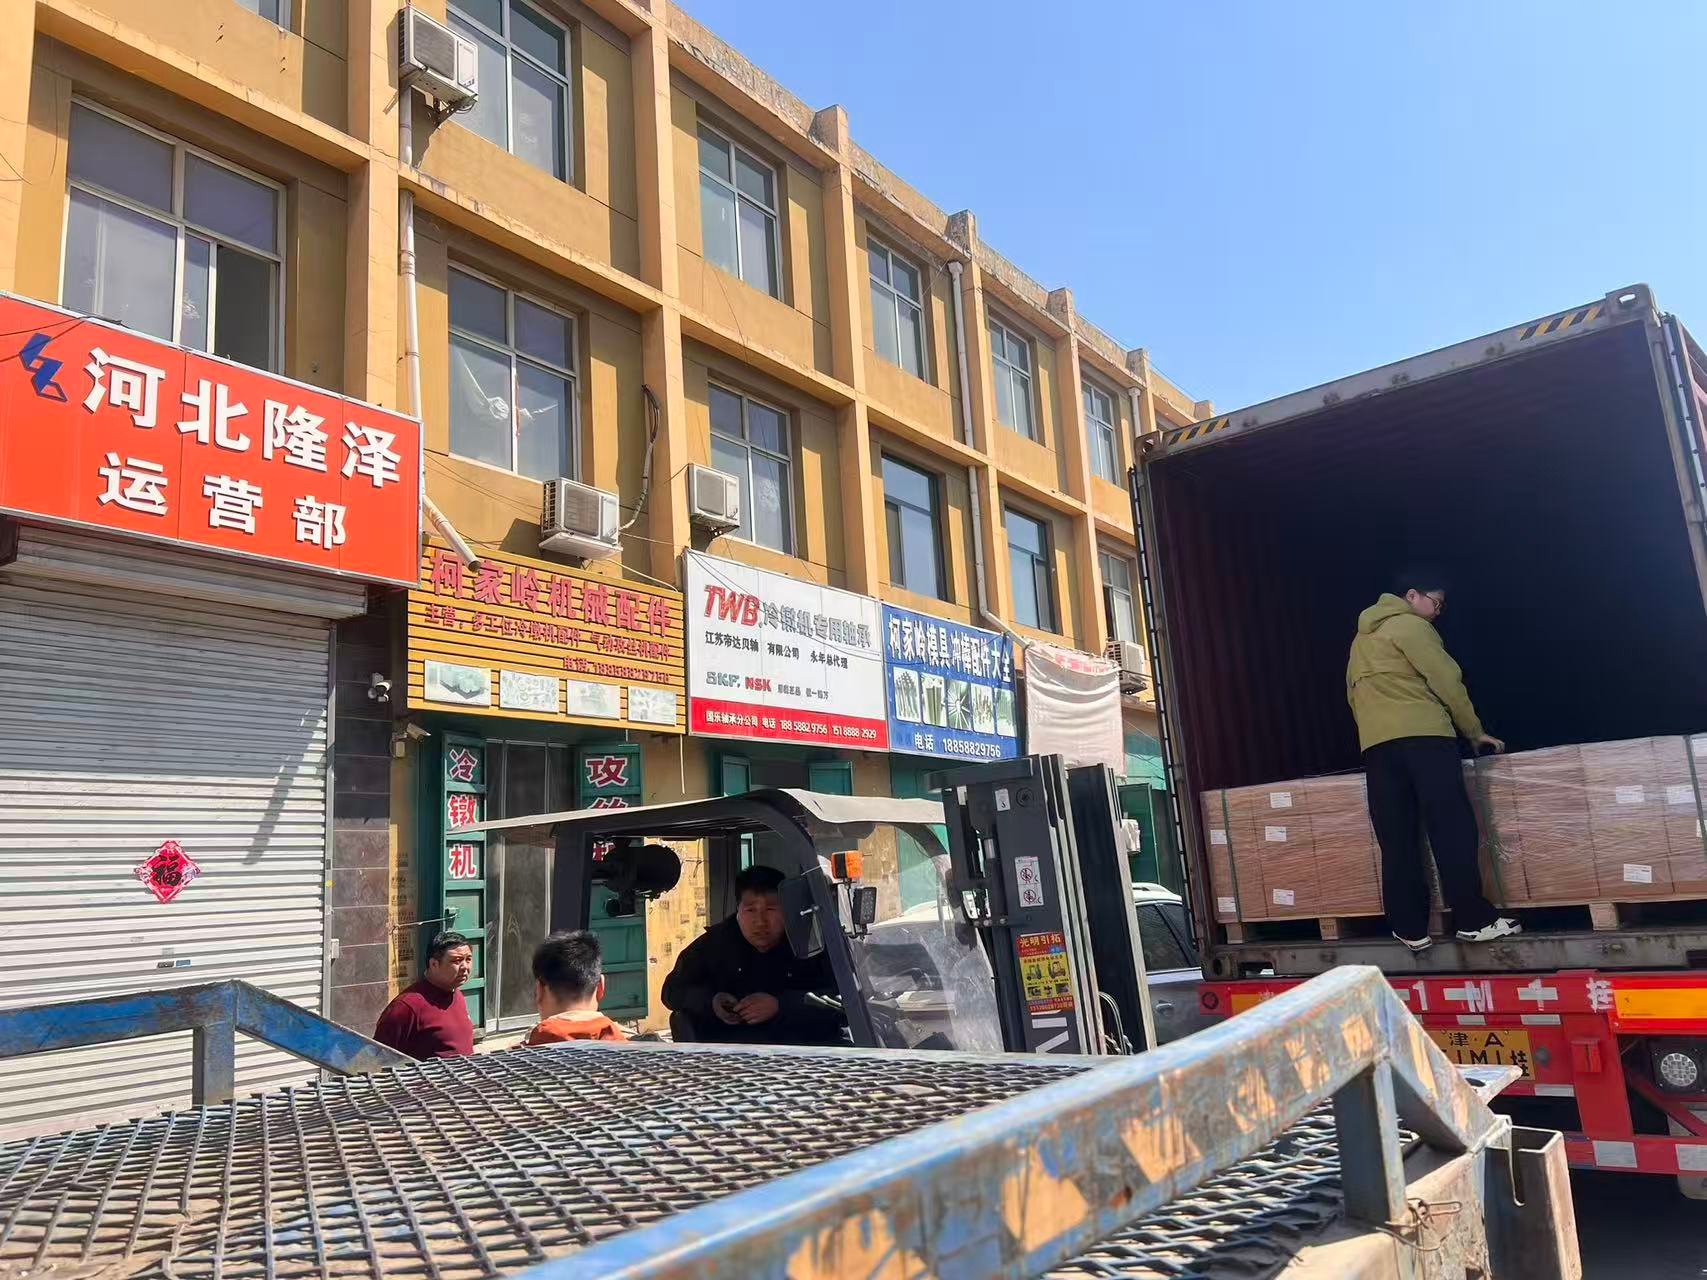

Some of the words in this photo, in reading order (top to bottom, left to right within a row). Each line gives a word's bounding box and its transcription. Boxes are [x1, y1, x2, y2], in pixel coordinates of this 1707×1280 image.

[83, 347, 402, 488] 河北隆泽
[97, 452, 347, 549] 运营部
[430, 550, 672, 638] 柯家岭机械配件
[767, 642, 800, 660] 有限公司
[745, 676, 772, 692] NSK
[762, 718, 776, 729] 电话
[914, 733, 934, 751] 电话
[942, 737, 1001, 758] 18858829756
